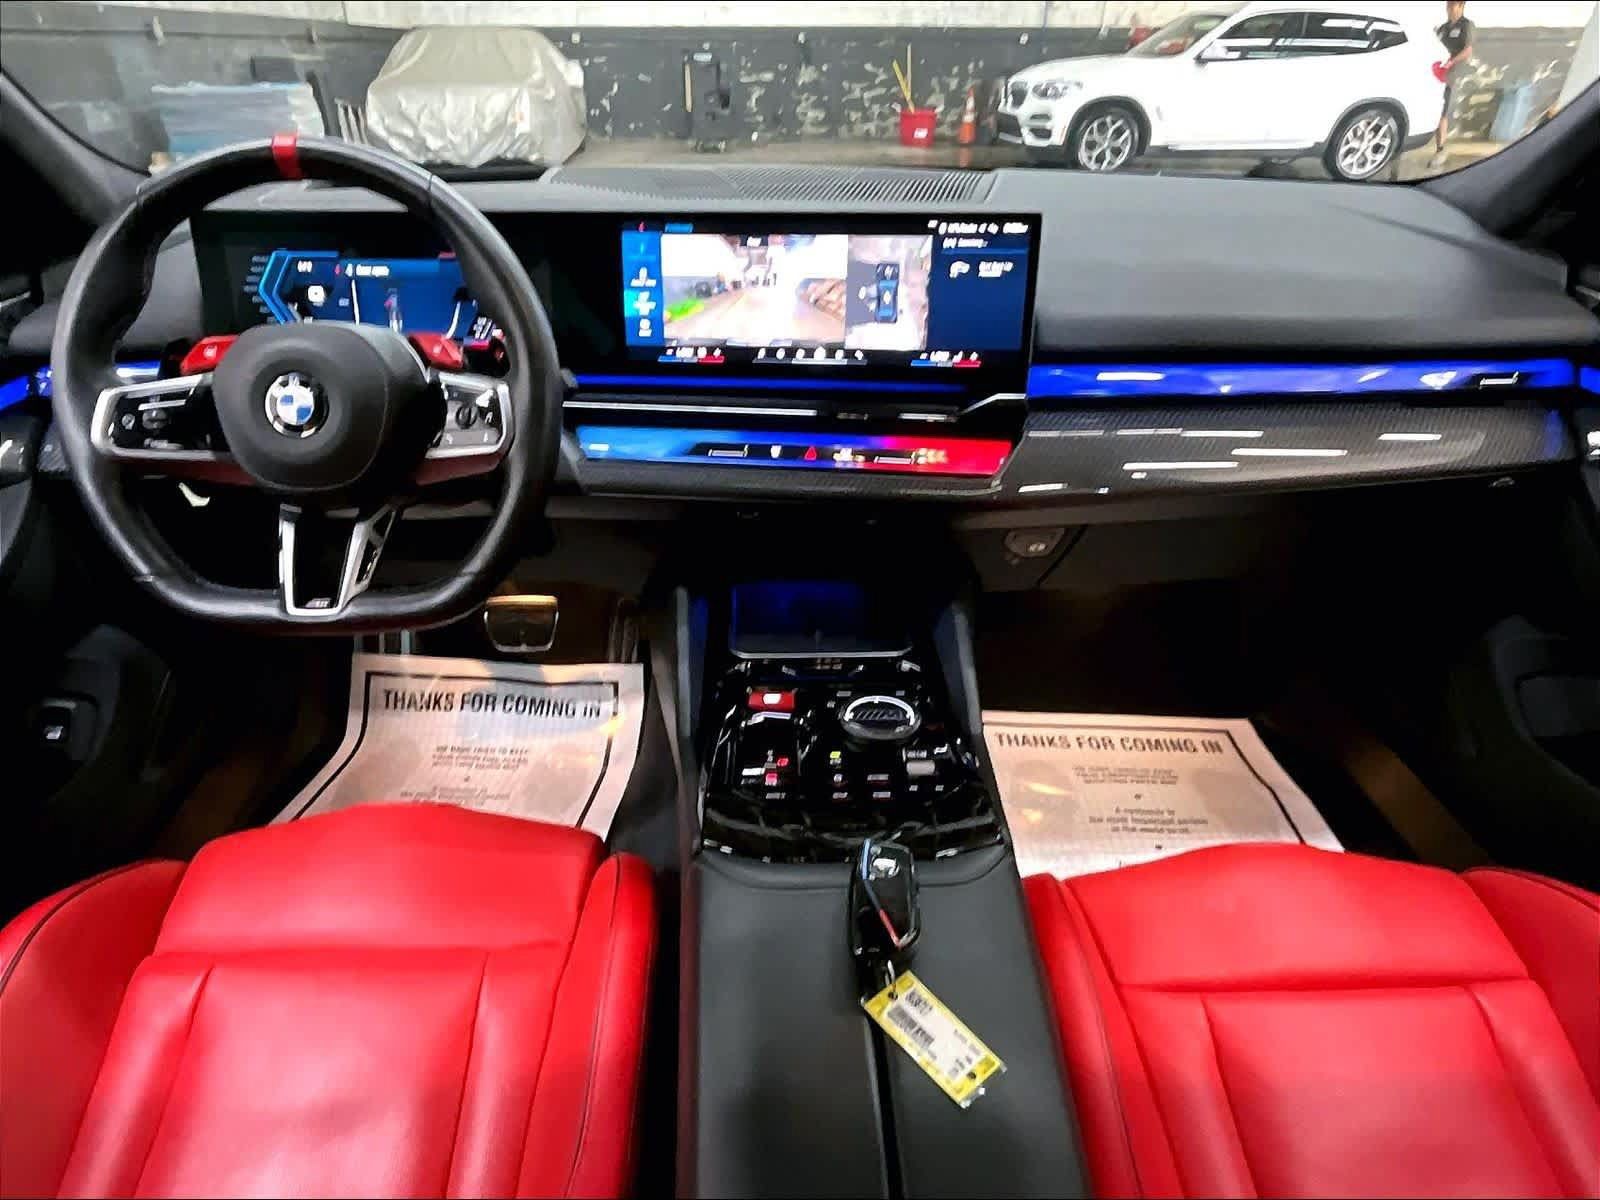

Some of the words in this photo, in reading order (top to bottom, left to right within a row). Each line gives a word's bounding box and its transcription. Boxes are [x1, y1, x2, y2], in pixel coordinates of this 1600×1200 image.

[384, 689, 454, 712] THANKS
[460, 692, 497, 713] FOR
[503, 695, 576, 718] COMING
[583, 700, 601, 718] IN
[996, 732, 1071, 749] THANKS
[1076, 735, 1115, 750] FOR
[1120, 736, 1196, 753] COMING
[1202, 739, 1224, 754] IN
